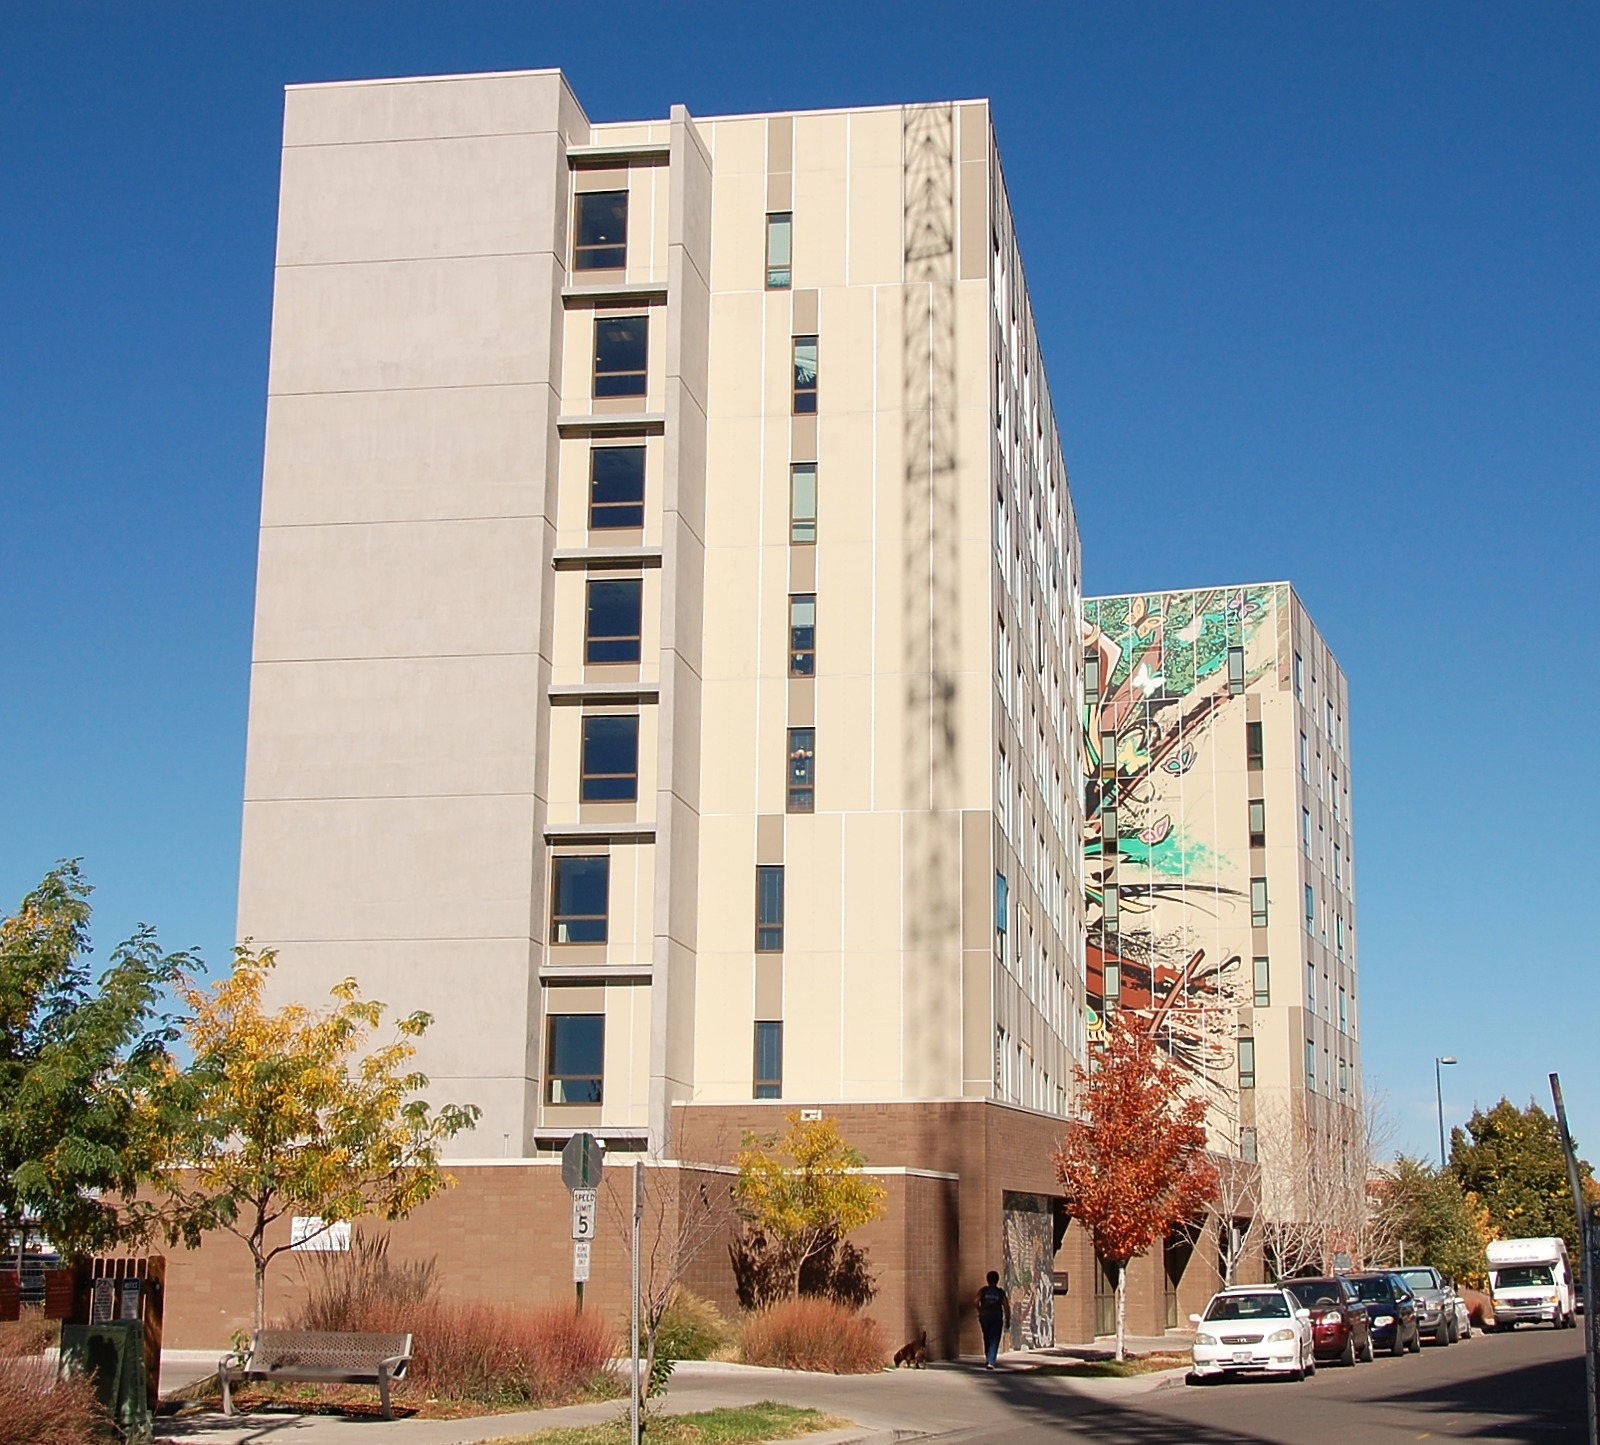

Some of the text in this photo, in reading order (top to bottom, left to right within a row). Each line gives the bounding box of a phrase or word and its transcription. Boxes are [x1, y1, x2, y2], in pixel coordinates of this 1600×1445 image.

[574, 1193, 595, 1202] SPEED
[575, 1204, 592, 1212] LIMIT
[578, 1215, 589, 1234] 5
